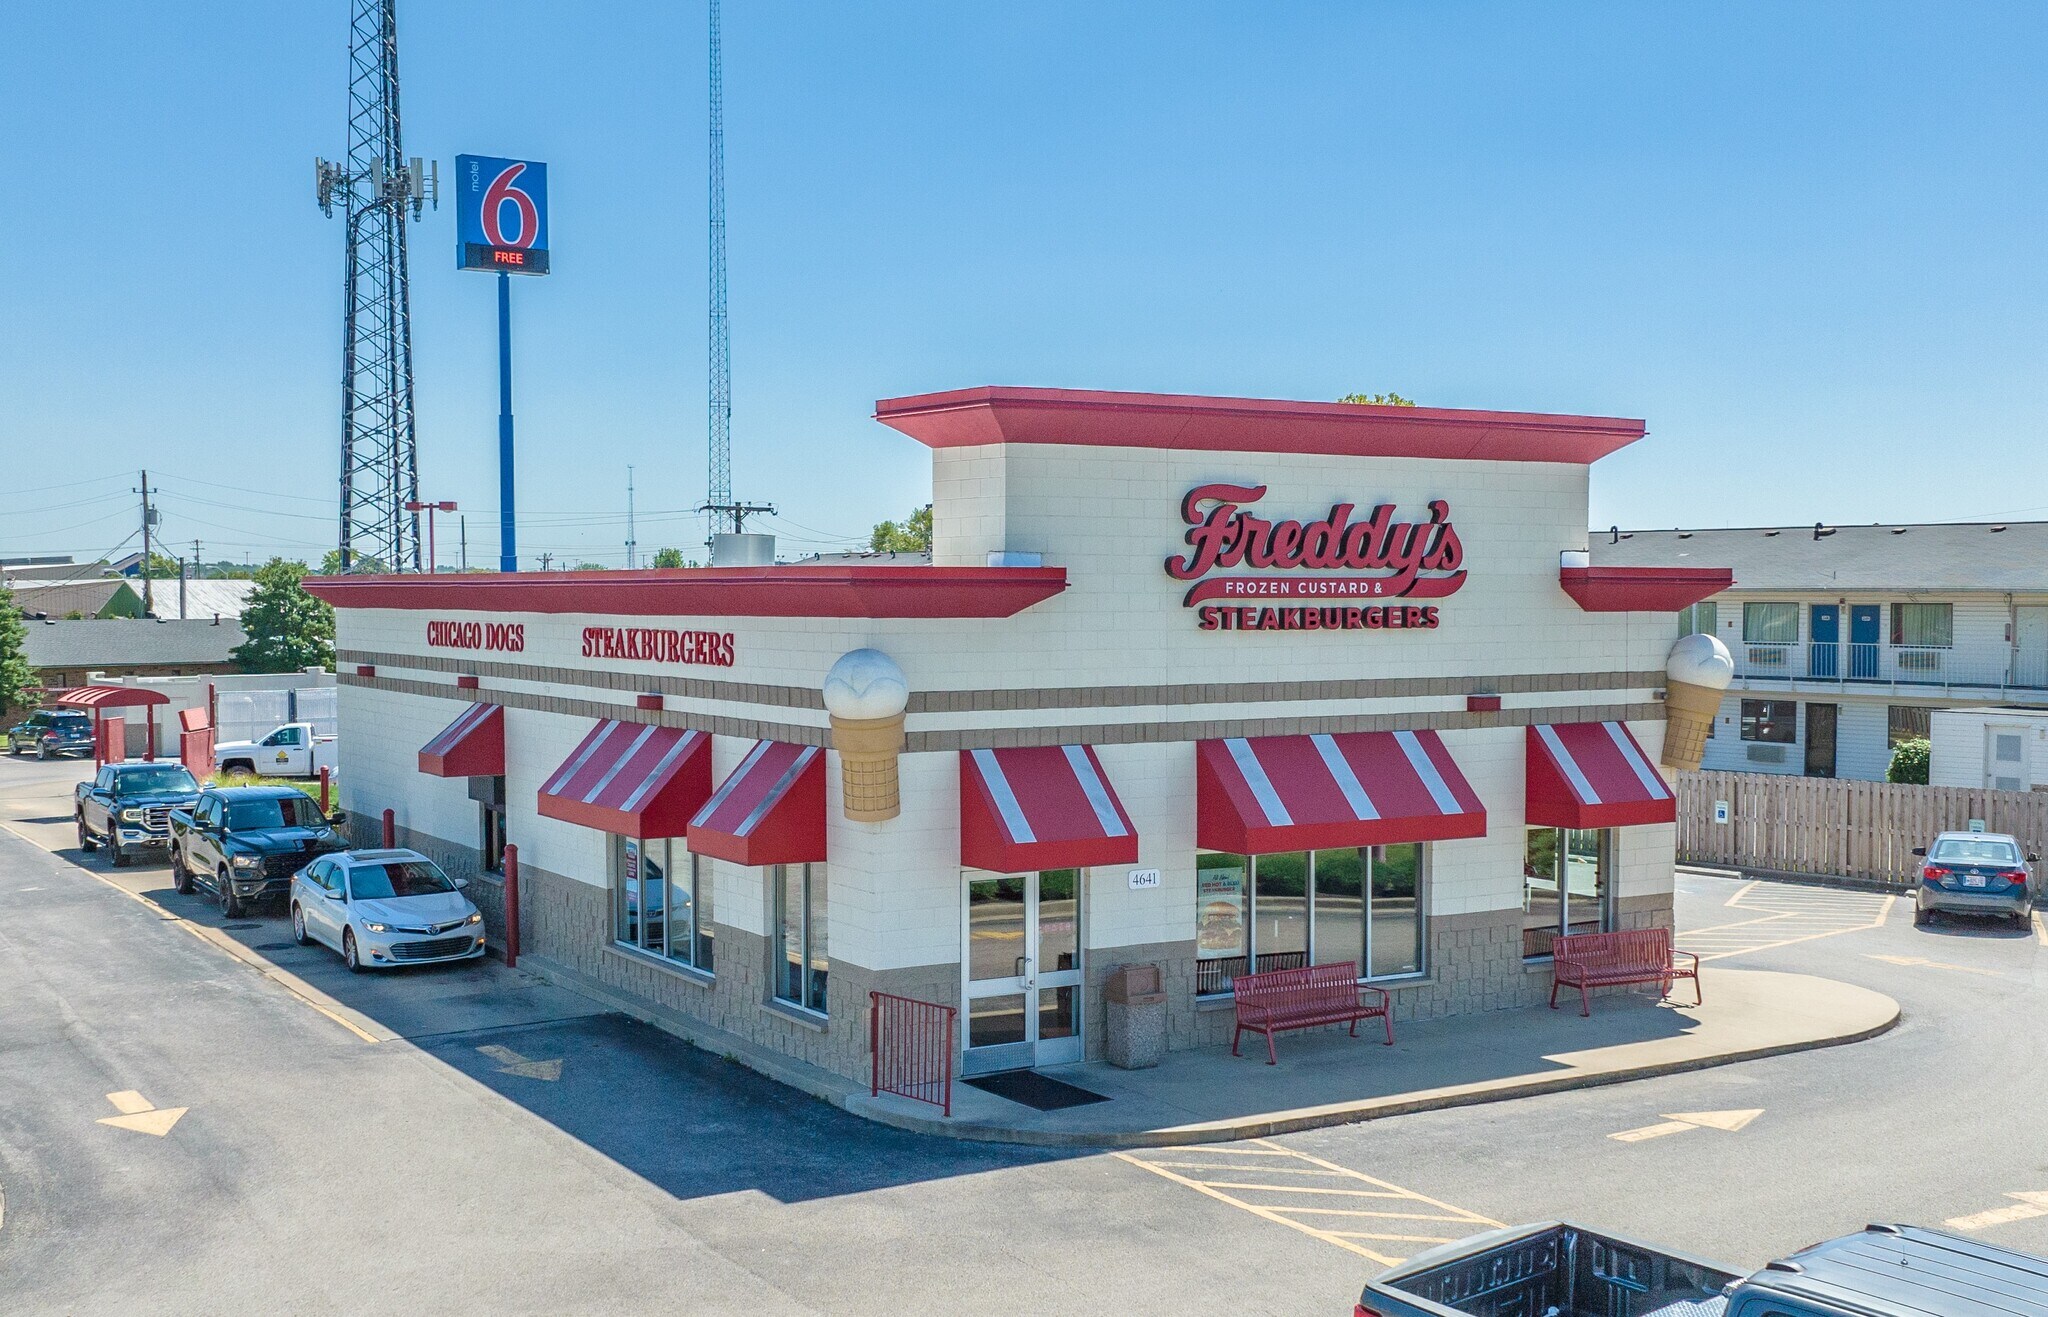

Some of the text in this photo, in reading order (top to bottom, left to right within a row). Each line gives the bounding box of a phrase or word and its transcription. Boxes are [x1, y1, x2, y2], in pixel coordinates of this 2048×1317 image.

[470, 161, 479, 192] motel
[480, 162, 539, 249] 6
[494, 251, 523, 264] FREE
[1164, 484, 1464, 597] Freddy's
[1225, 582, 1383, 594] FROZEN CUSTARD &
[1199, 606, 1439, 630] STEAKBURGERS
[427, 620, 524, 652] CHICAGO DOGS
[582, 627, 735, 667] STEAKBURGERS
[1132, 873, 1157, 886] 4641
